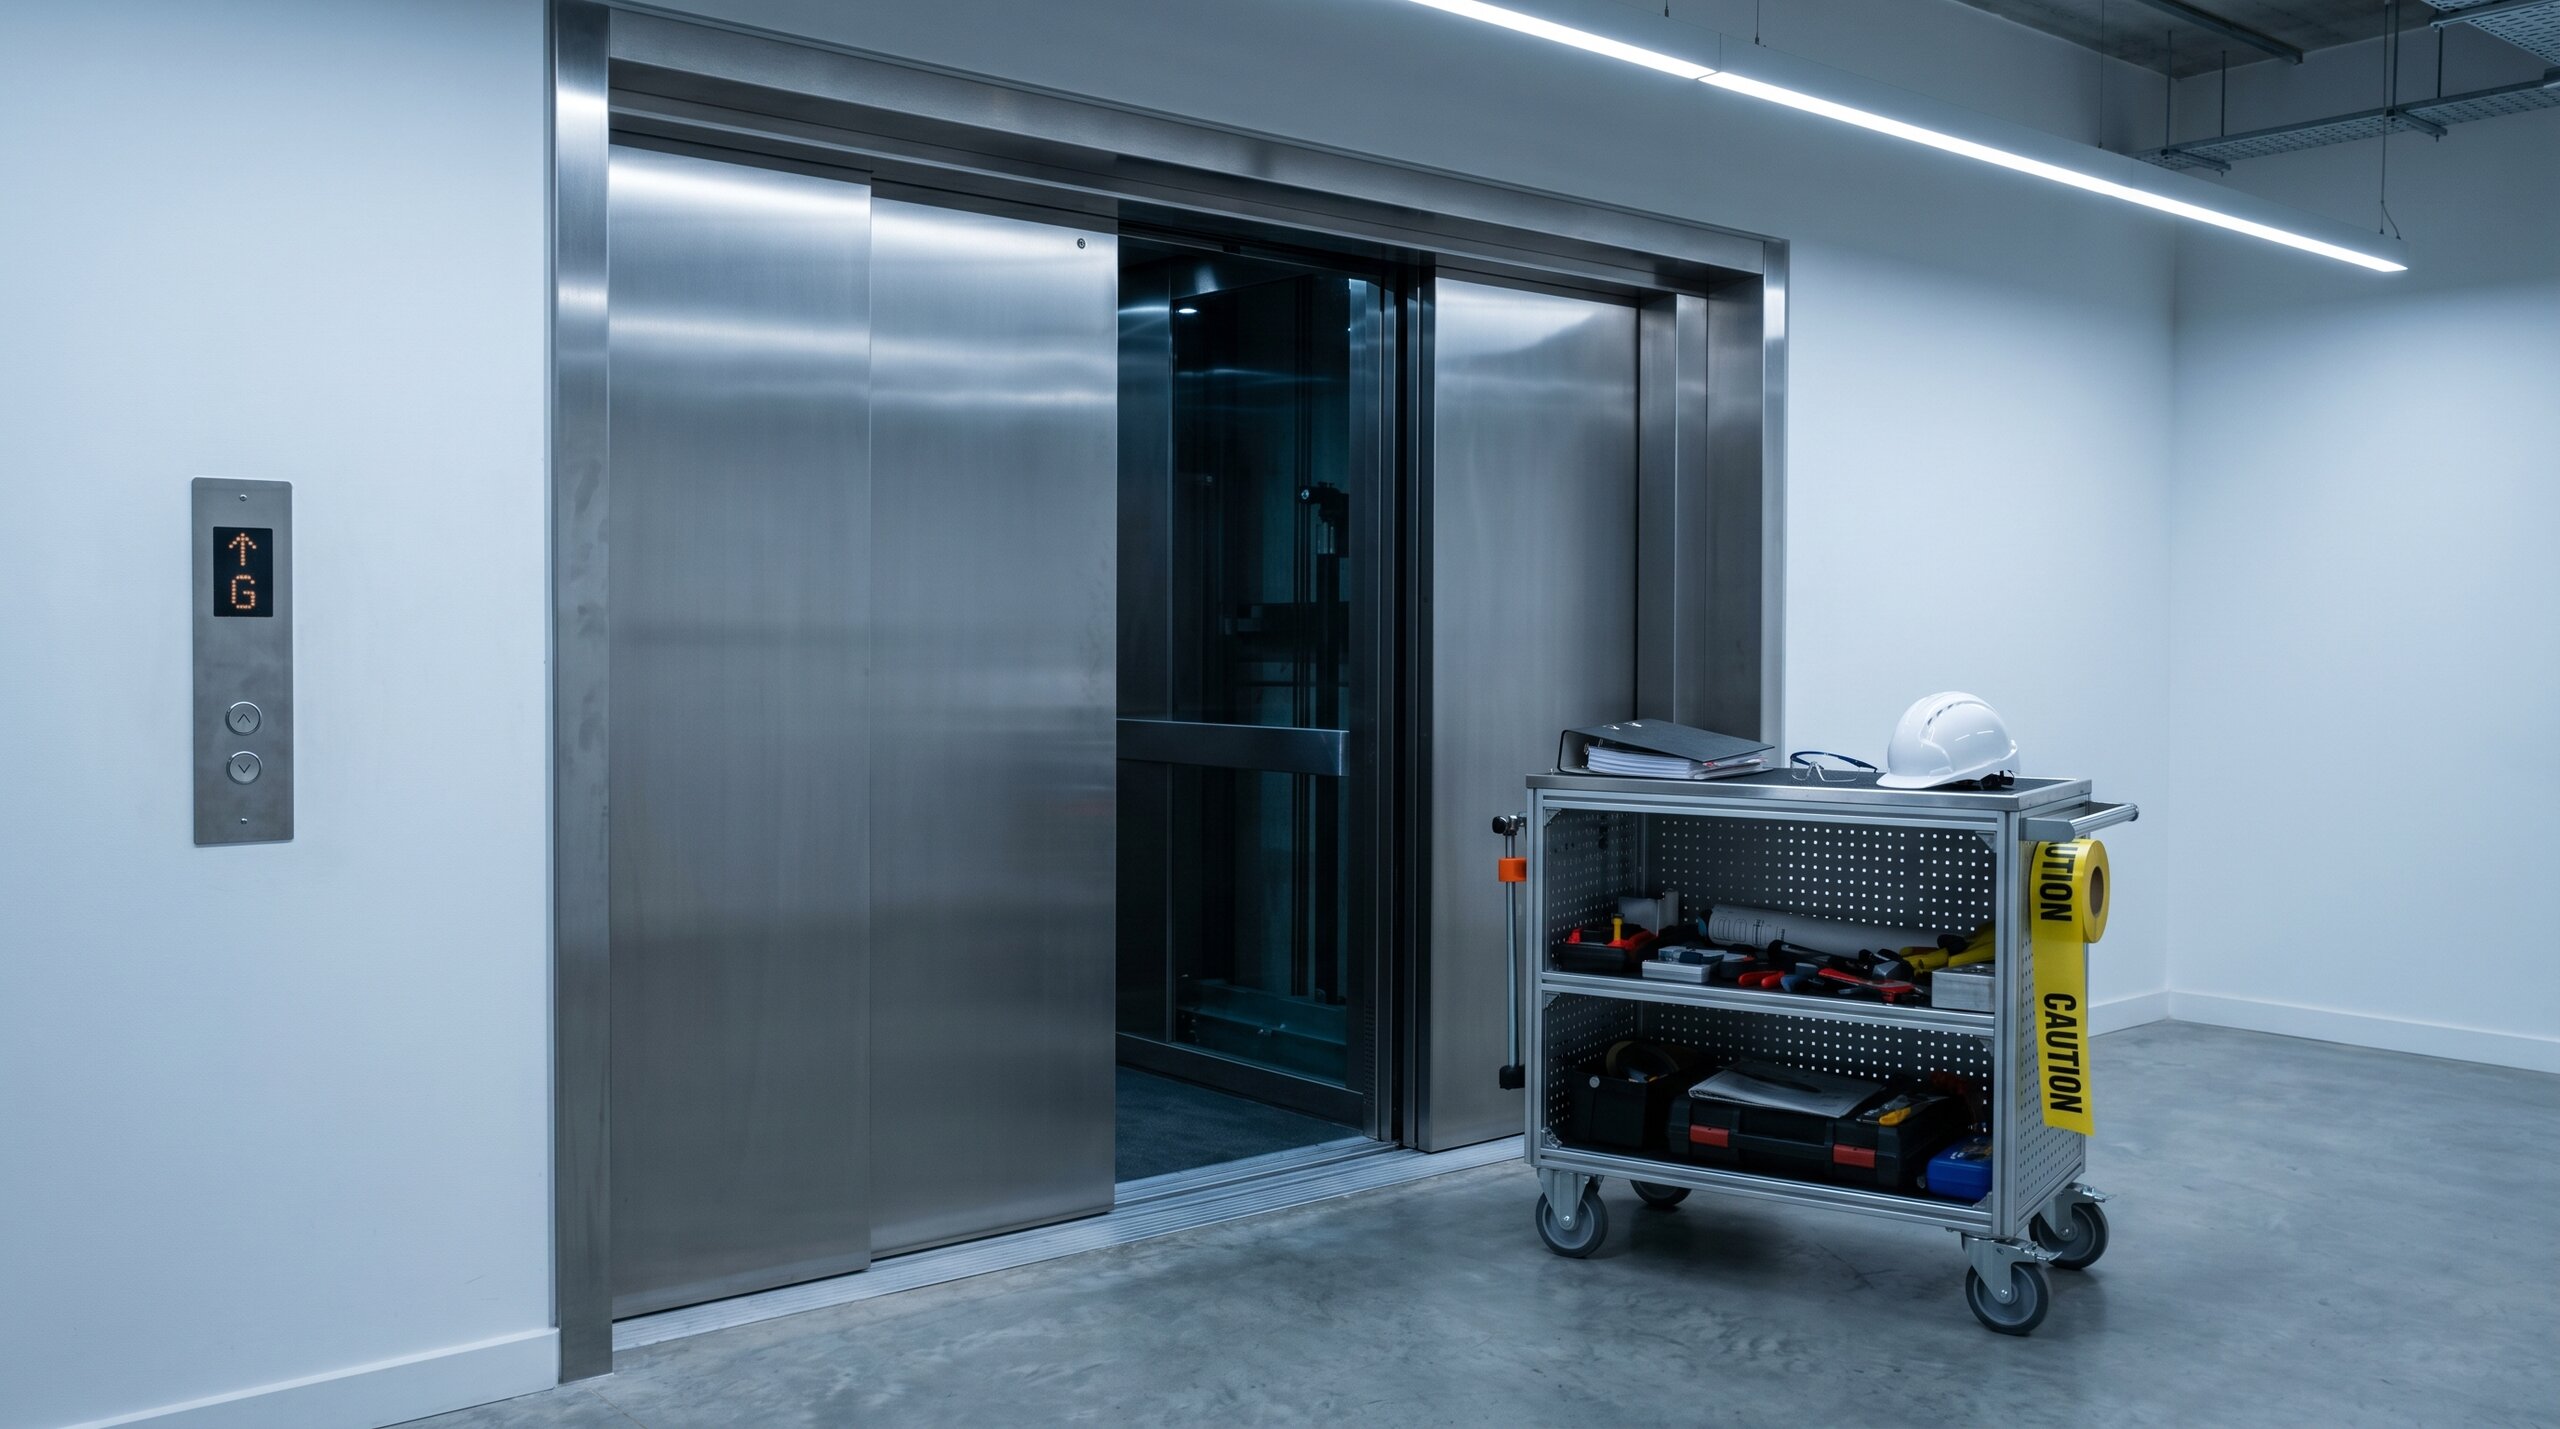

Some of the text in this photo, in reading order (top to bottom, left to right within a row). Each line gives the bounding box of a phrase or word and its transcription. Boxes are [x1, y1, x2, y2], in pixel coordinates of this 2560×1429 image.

[231, 574, 256, 609] G
[2040, 842, 2080, 922] UTION
[2043, 993, 2083, 1114] CAUTION
